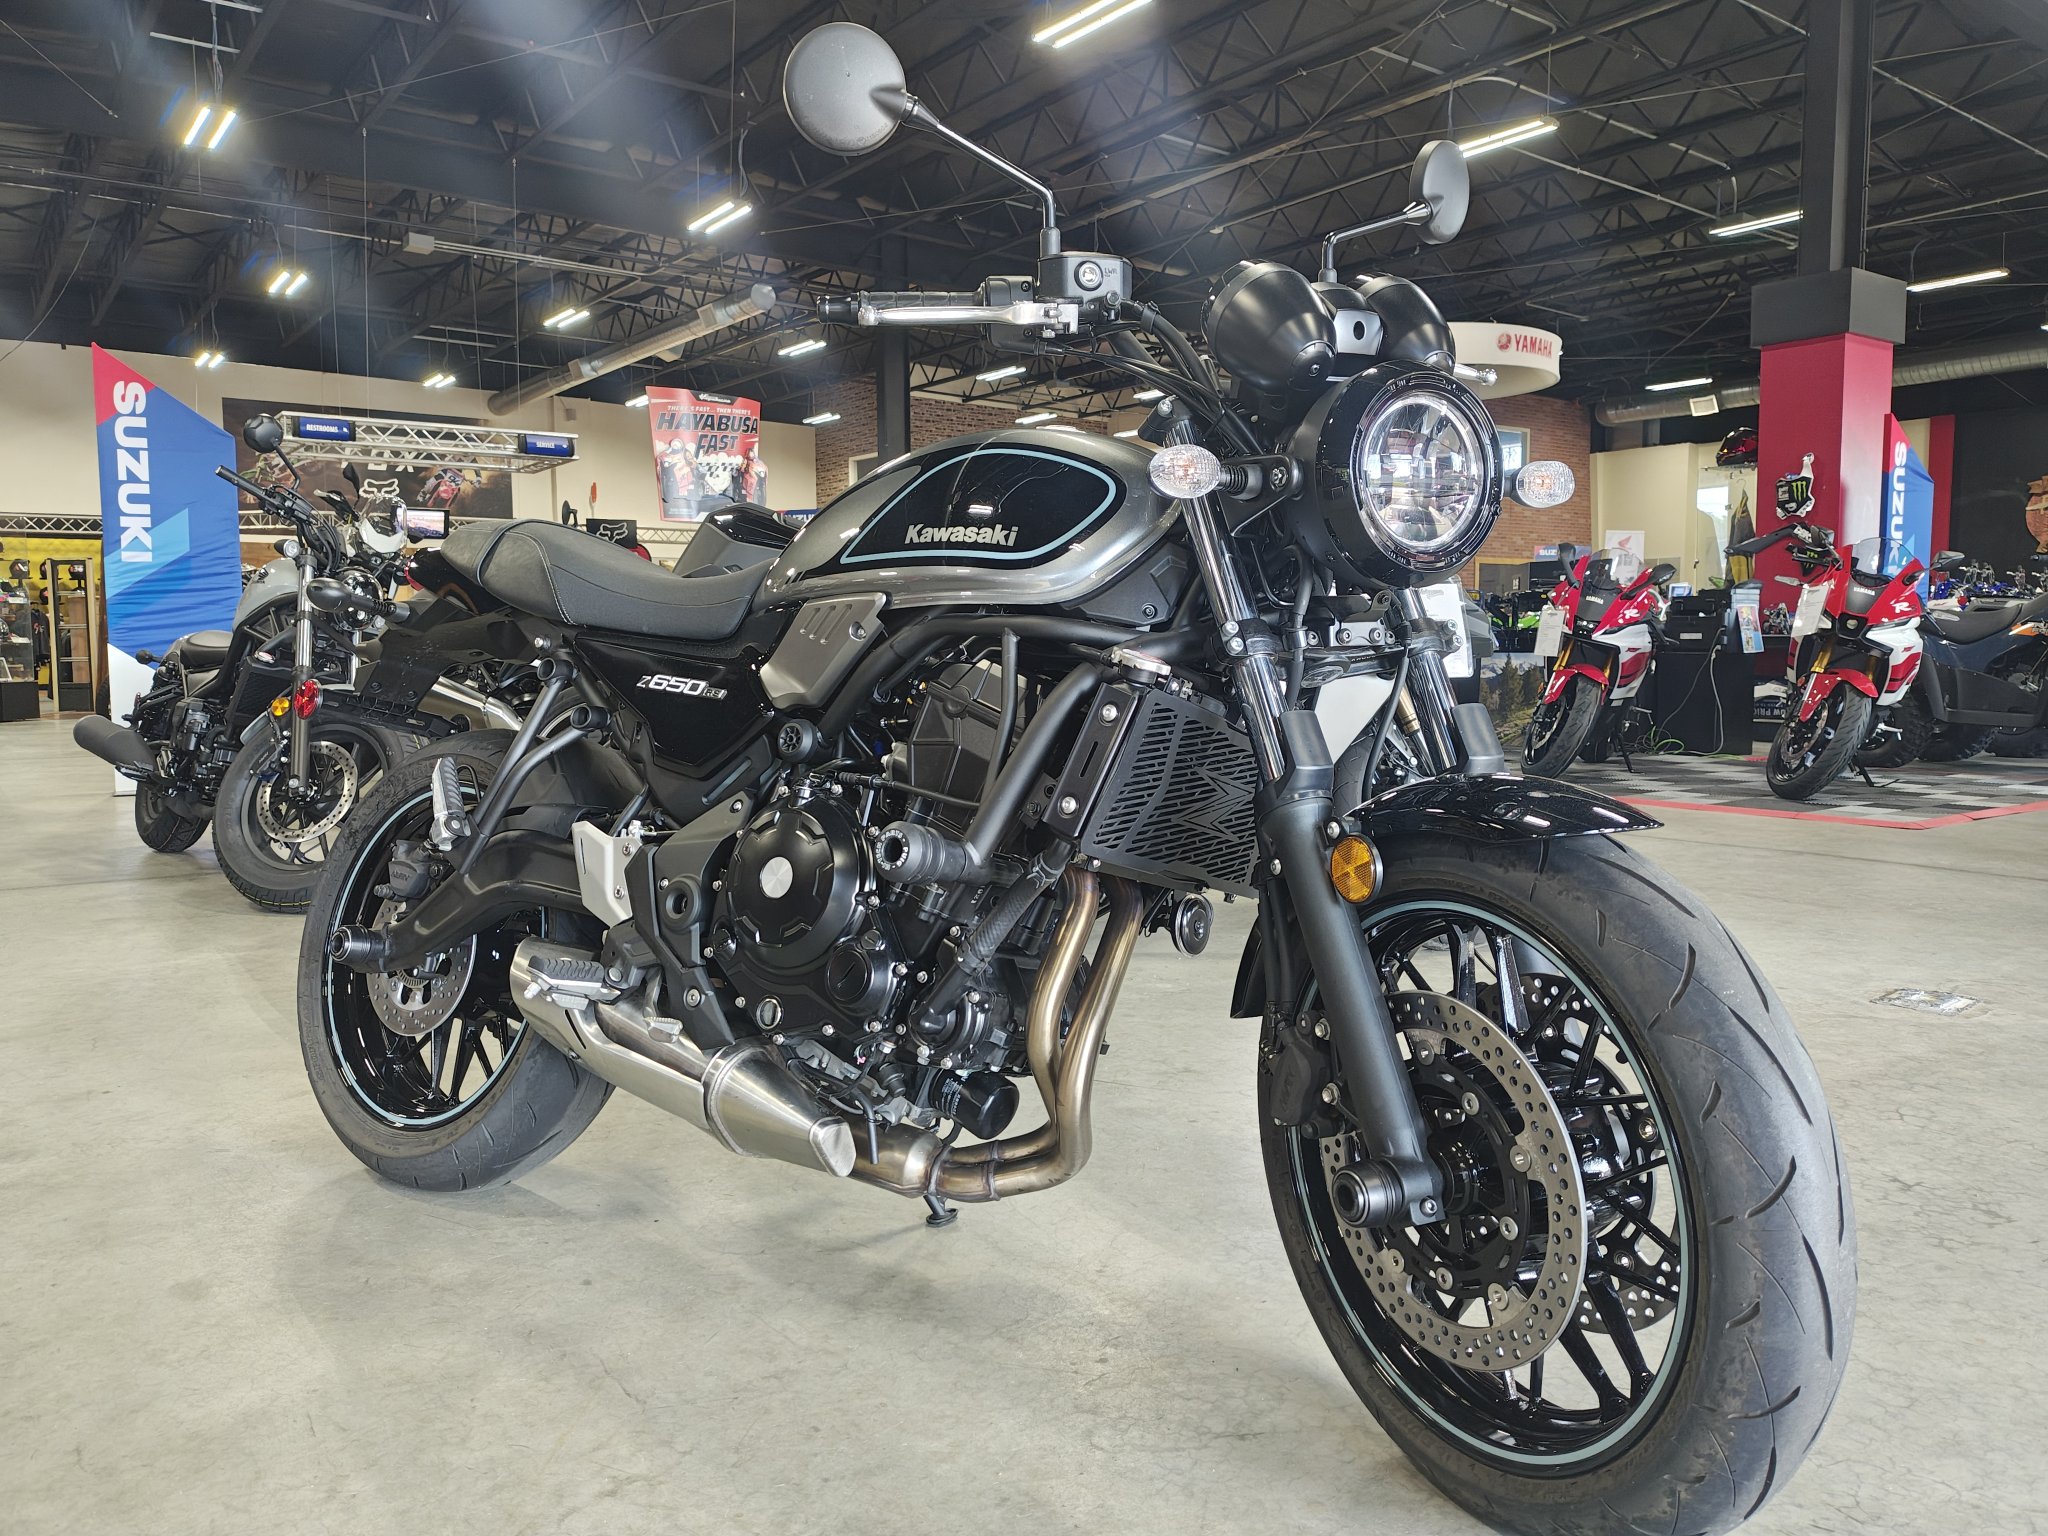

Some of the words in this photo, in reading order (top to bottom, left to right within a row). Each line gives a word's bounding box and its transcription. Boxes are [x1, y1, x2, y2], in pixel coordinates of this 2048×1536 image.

[1514, 333, 1553, 358] YAMAHA
[306, 423, 339, 433] RESTROOMS
[655, 412, 759, 435] HAYABUSA
[694, 433, 739, 460] FAST
[113, 380, 152, 562] SUZUKI
[904, 523, 1018, 547] Kawasaki
[1854, 586, 1875, 596] YAMAHA
